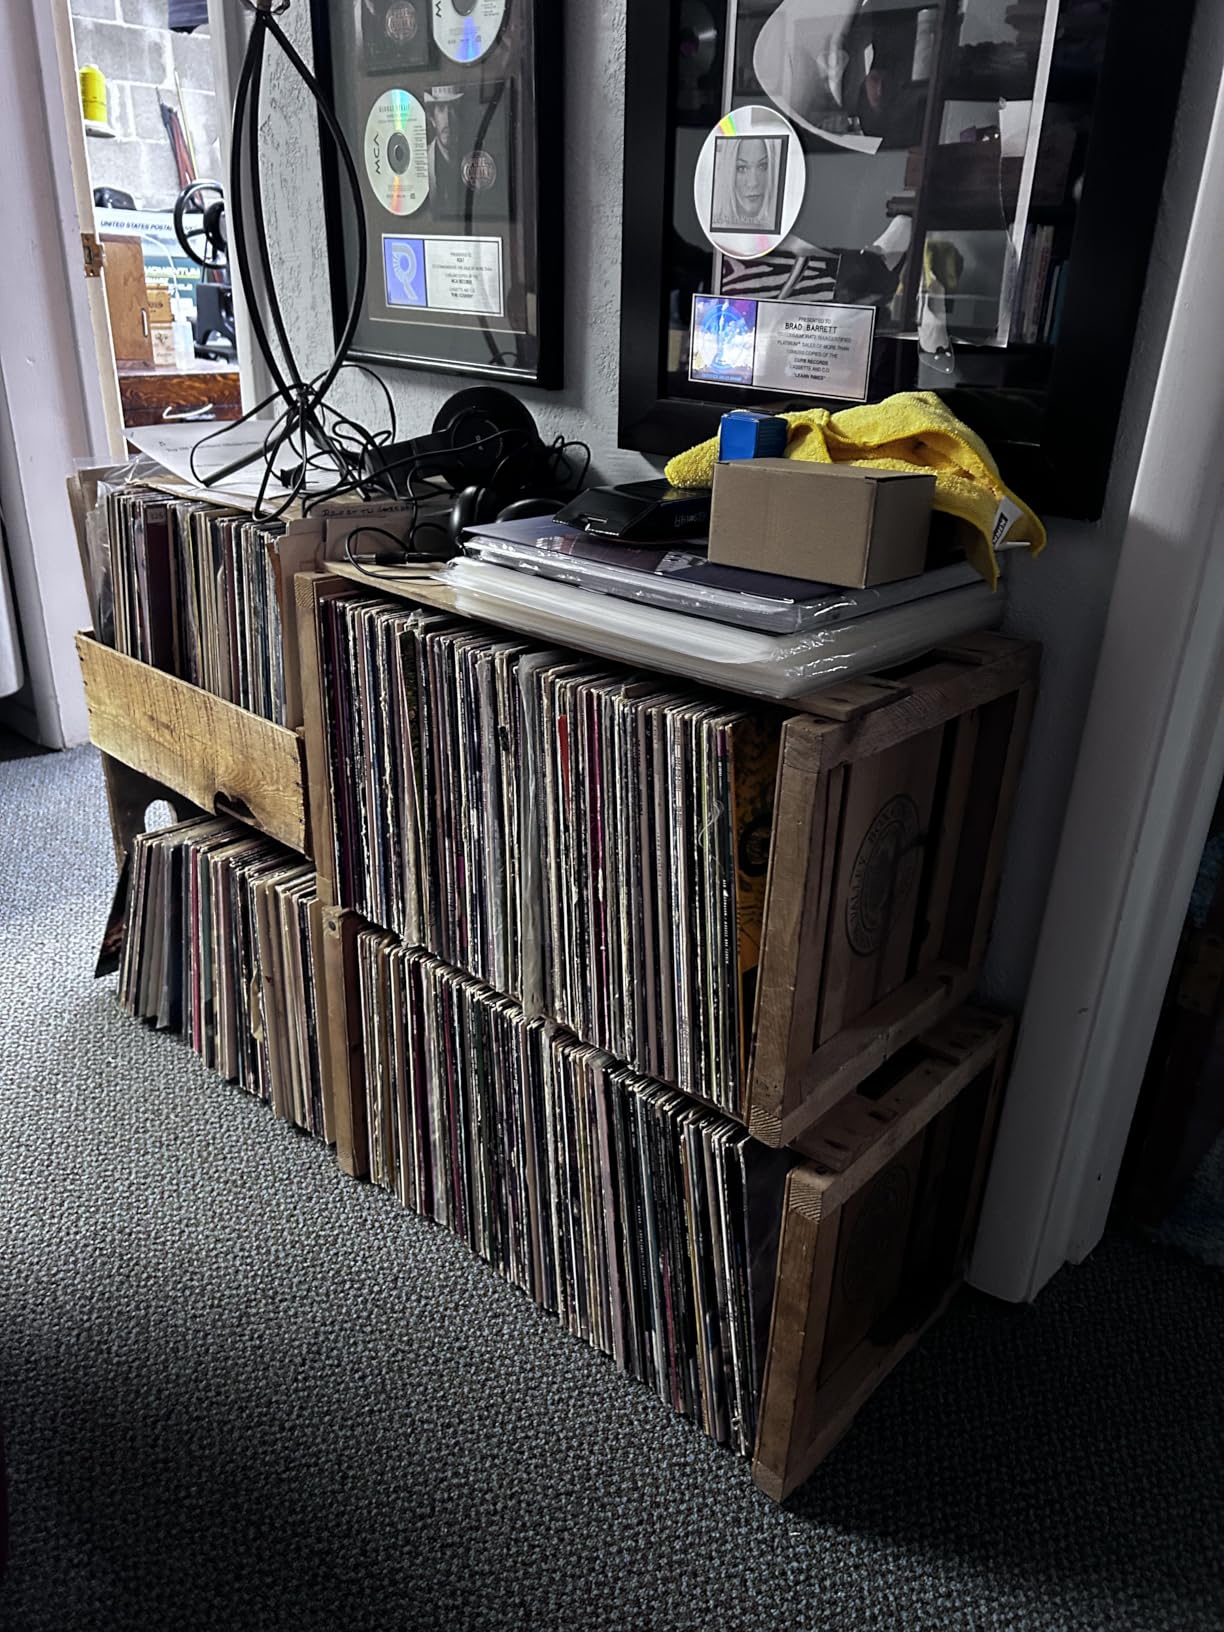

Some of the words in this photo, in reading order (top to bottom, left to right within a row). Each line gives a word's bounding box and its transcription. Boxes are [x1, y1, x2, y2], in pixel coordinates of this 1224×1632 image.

[373, 131, 382, 175] MCA
[100, 220, 125, 228] UNITED
[126, 221, 149, 230] STATES
[785, 323, 803, 331] BRAD
[806, 325, 838, 334] BARRETT
